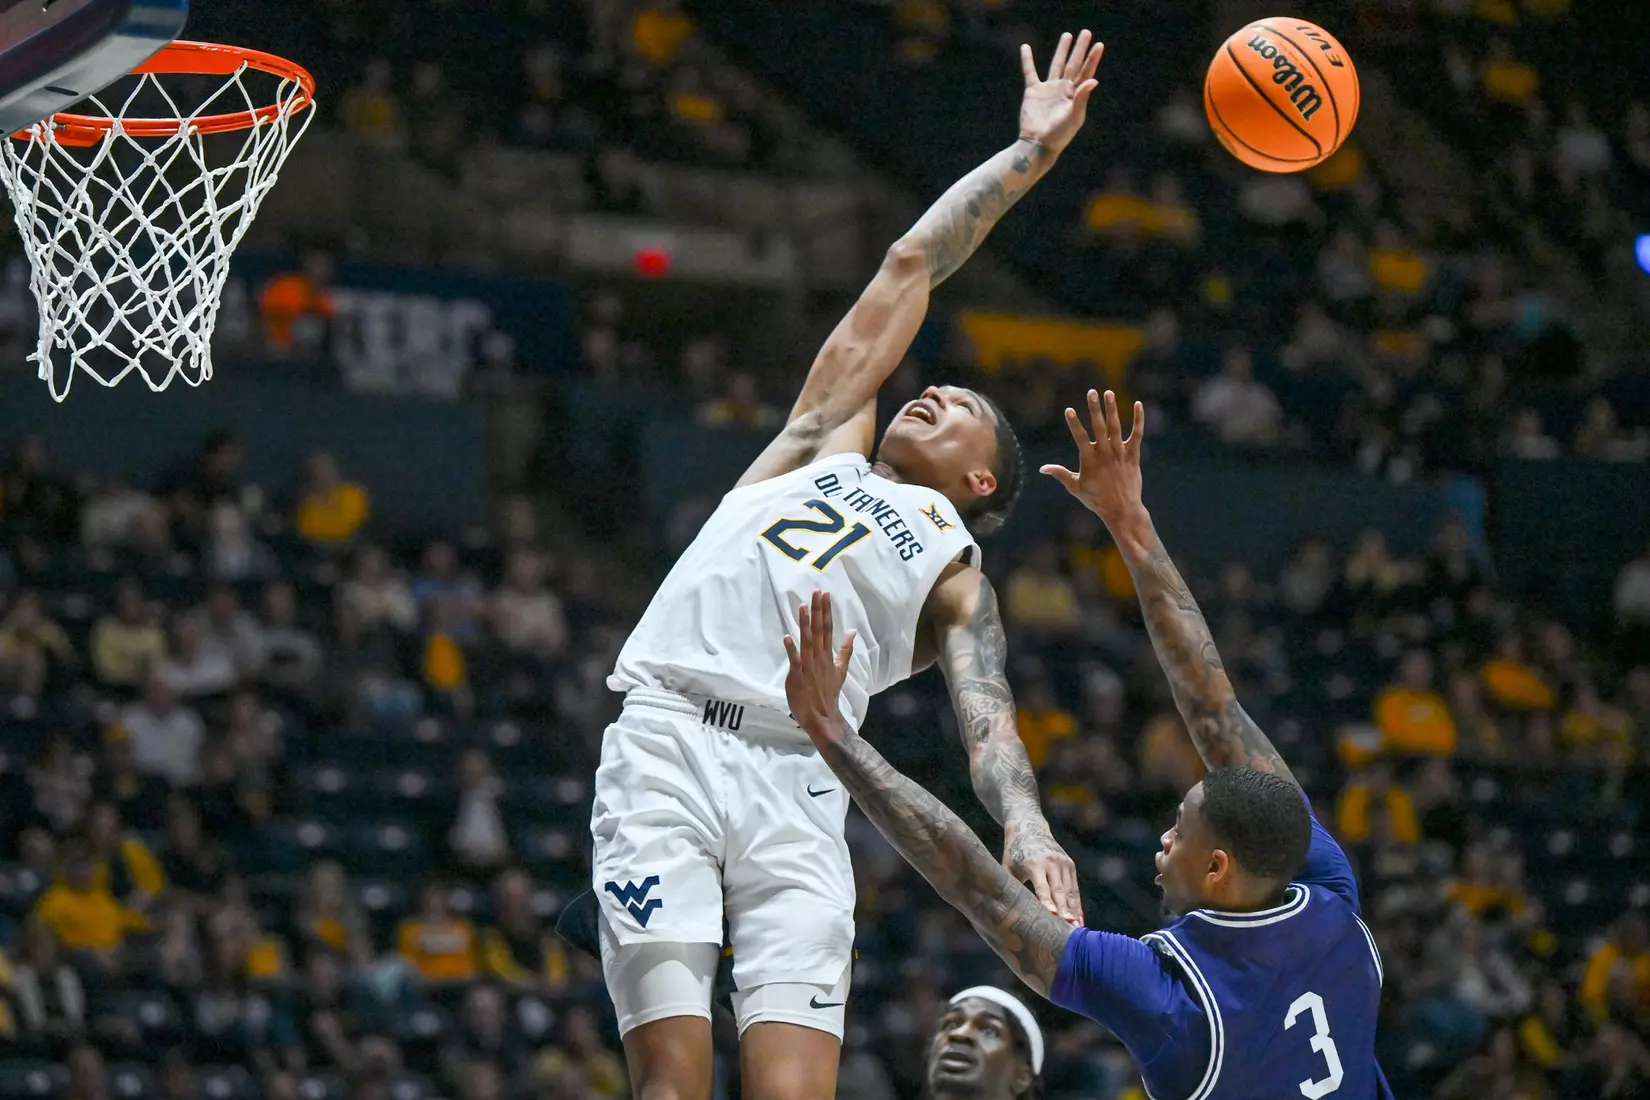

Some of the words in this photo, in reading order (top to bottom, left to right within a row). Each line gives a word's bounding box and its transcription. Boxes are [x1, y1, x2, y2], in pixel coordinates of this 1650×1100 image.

[1248, 34, 1322, 122] Wilson
[760, 499, 873, 572] 21
[702, 699, 744, 731] WVU
[1284, 991, 1344, 1100] 3
